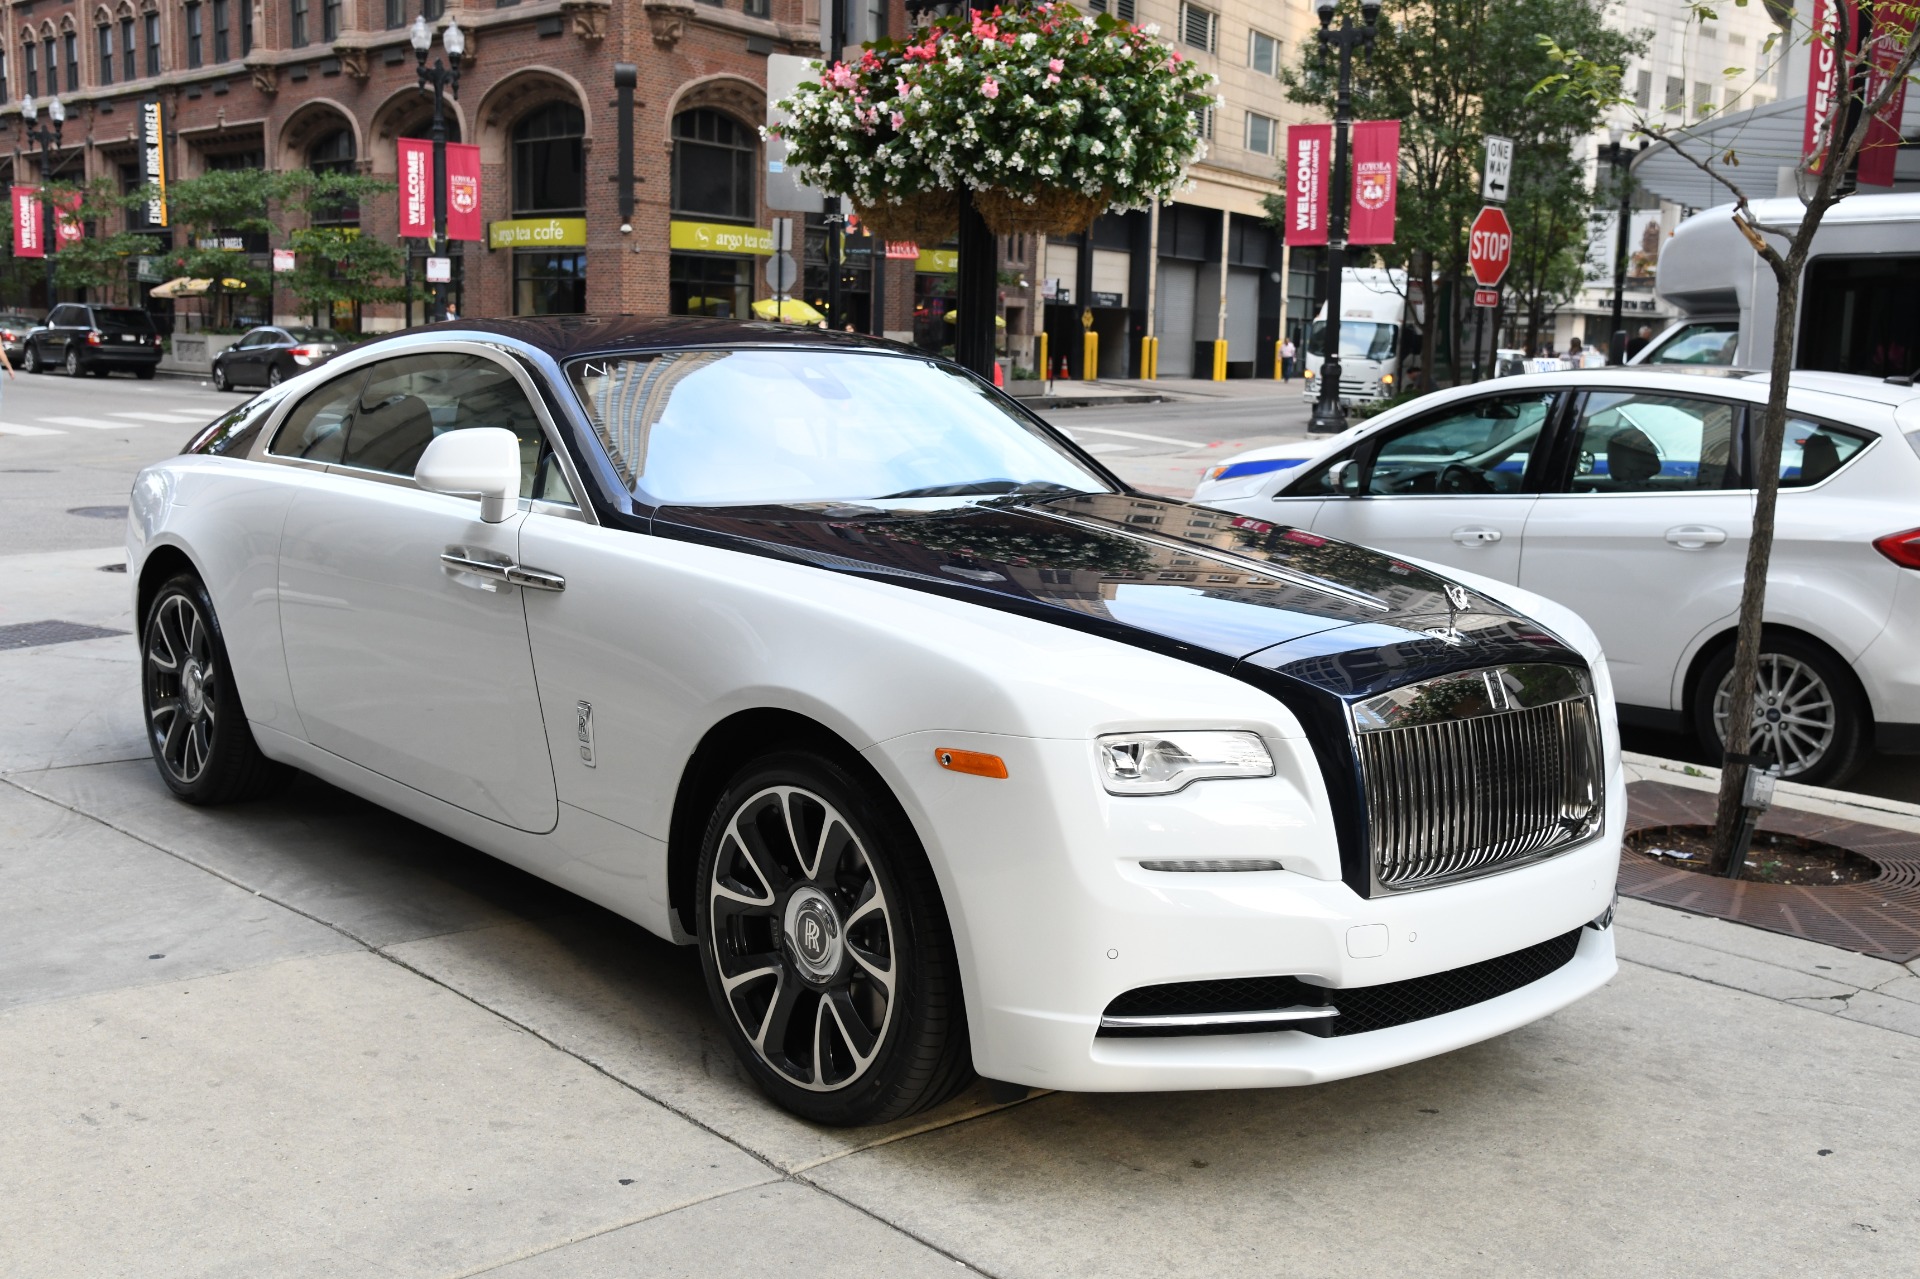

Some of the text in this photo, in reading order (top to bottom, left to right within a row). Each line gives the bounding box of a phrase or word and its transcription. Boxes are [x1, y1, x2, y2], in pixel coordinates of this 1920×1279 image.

[1812, 0, 1838, 145] WELCOM
[144, 103, 158, 144] BAGELS
[1312, 139, 1320, 173] CAMPUS
[1490, 143, 1510, 160] ONE
[1357, 162, 1392, 171] LOYOLA
[1488, 161, 1508, 176] WAY
[407, 151, 419, 225] WELCOME
[1297, 139, 1311, 230] WELCOME
[516, 226, 531, 240] tea
[533, 219, 564, 240] café
[716, 233, 742, 250] argo
[744, 232, 758, 248] tea
[1471, 230, 1509, 261] STOP
[1477, 293, 1486, 303] ALL
